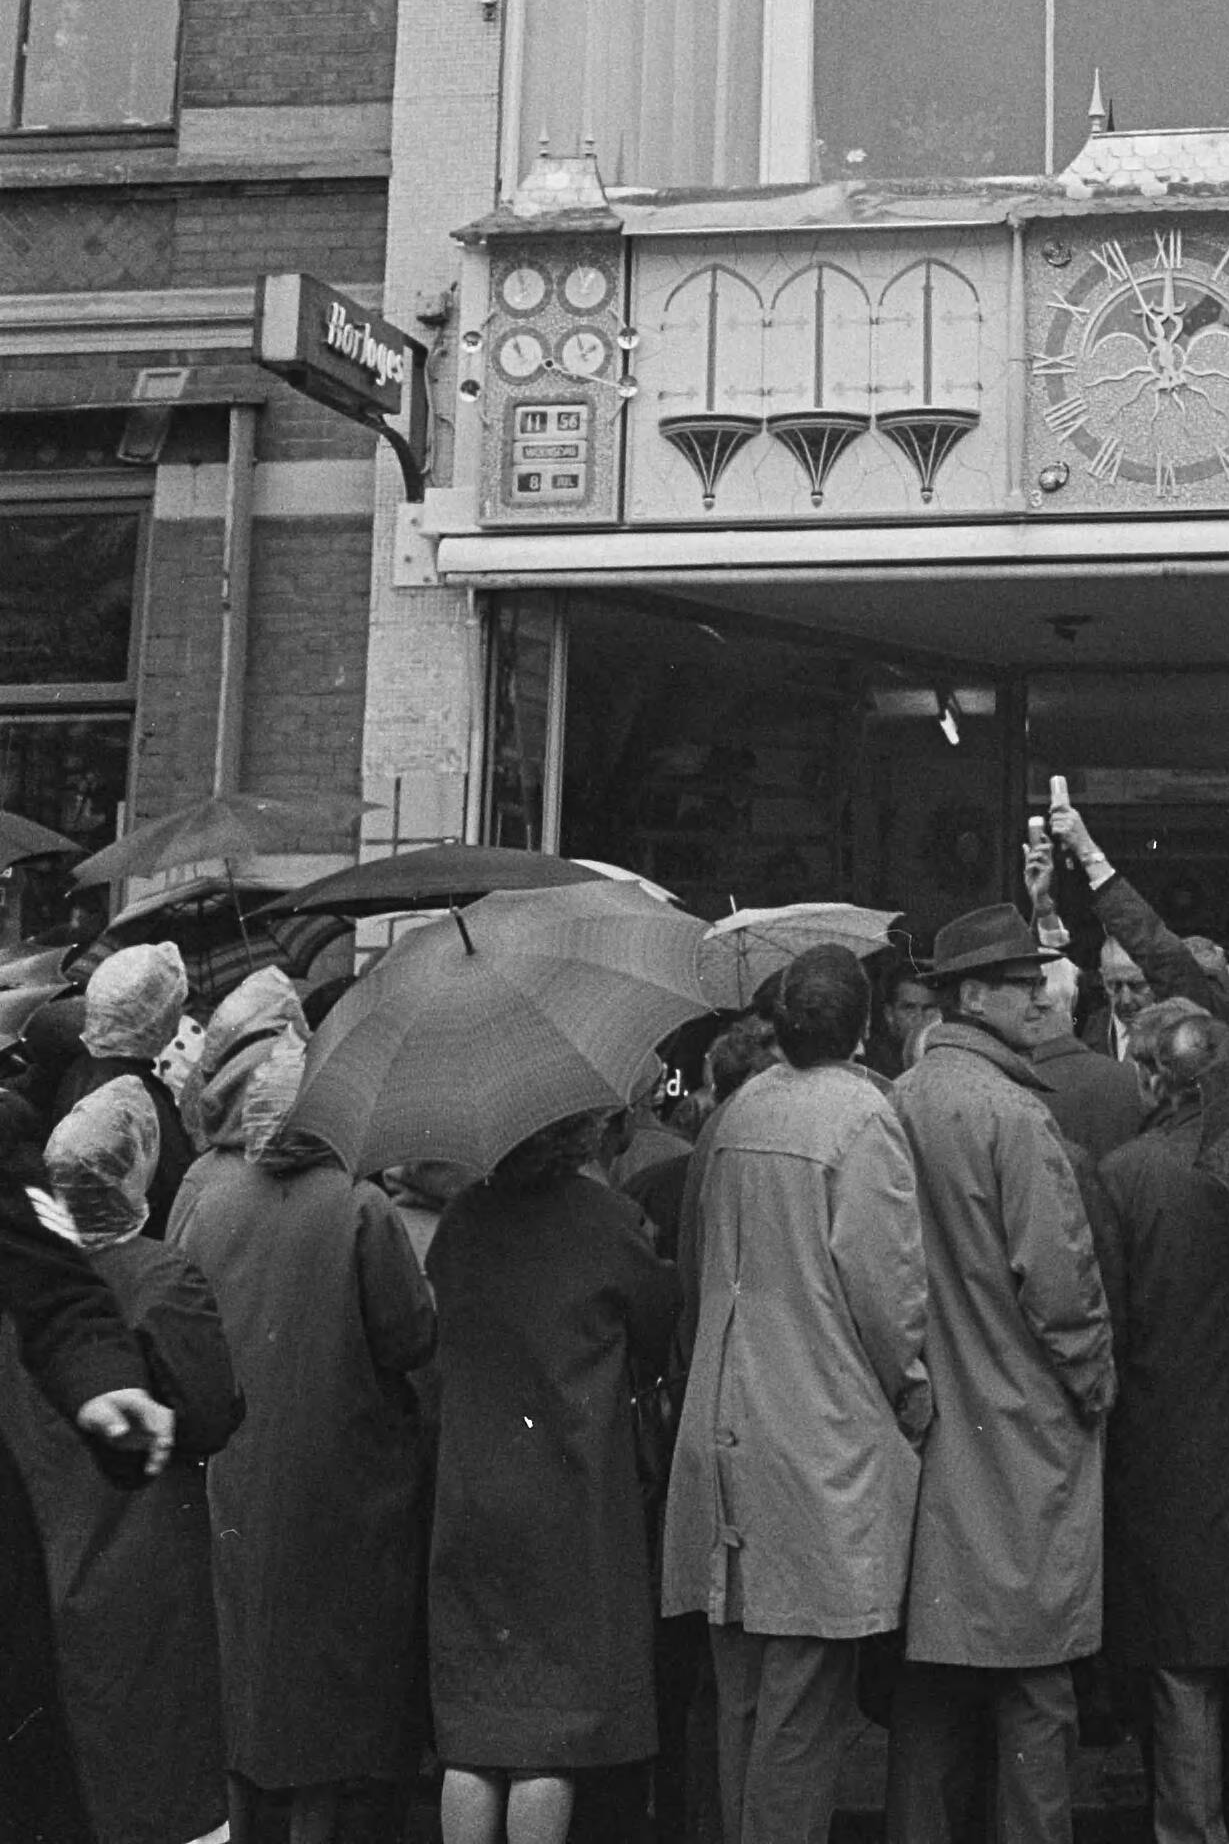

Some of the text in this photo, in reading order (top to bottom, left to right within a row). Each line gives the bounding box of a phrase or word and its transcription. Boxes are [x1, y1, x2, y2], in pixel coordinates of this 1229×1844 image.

[326, 301, 405, 387] Horloges
[526, 413, 578, 432] 11 56
[529, 475, 539, 490] 8
[1029, 491, 1043, 507] 3
